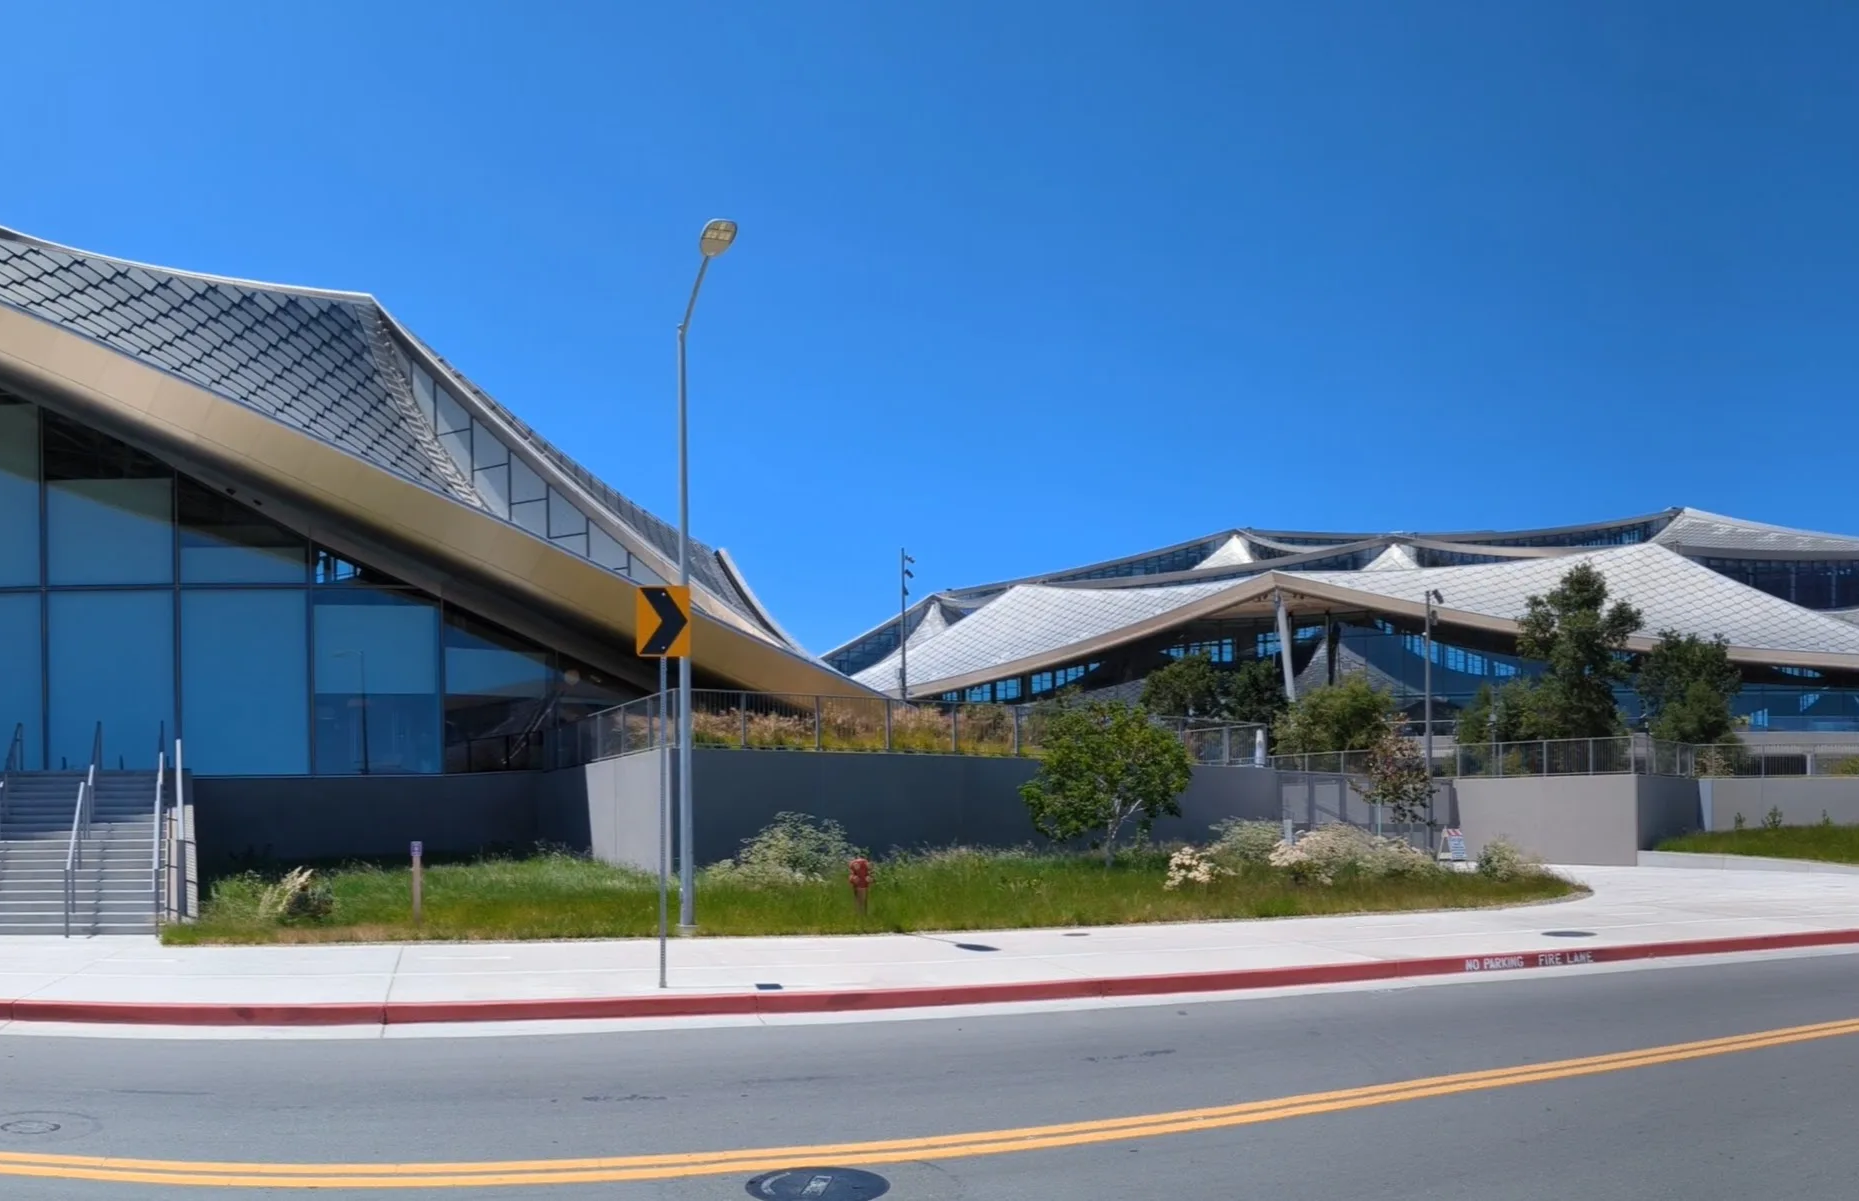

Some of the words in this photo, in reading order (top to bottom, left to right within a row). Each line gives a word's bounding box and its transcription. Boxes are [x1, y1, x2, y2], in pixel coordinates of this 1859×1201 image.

[1465, 960, 1480, 972] NO
[1484, 956, 1524, 970] PARKING
[1538, 954, 1562, 966] FIRE
[1567, 952, 1594, 964] LANE
